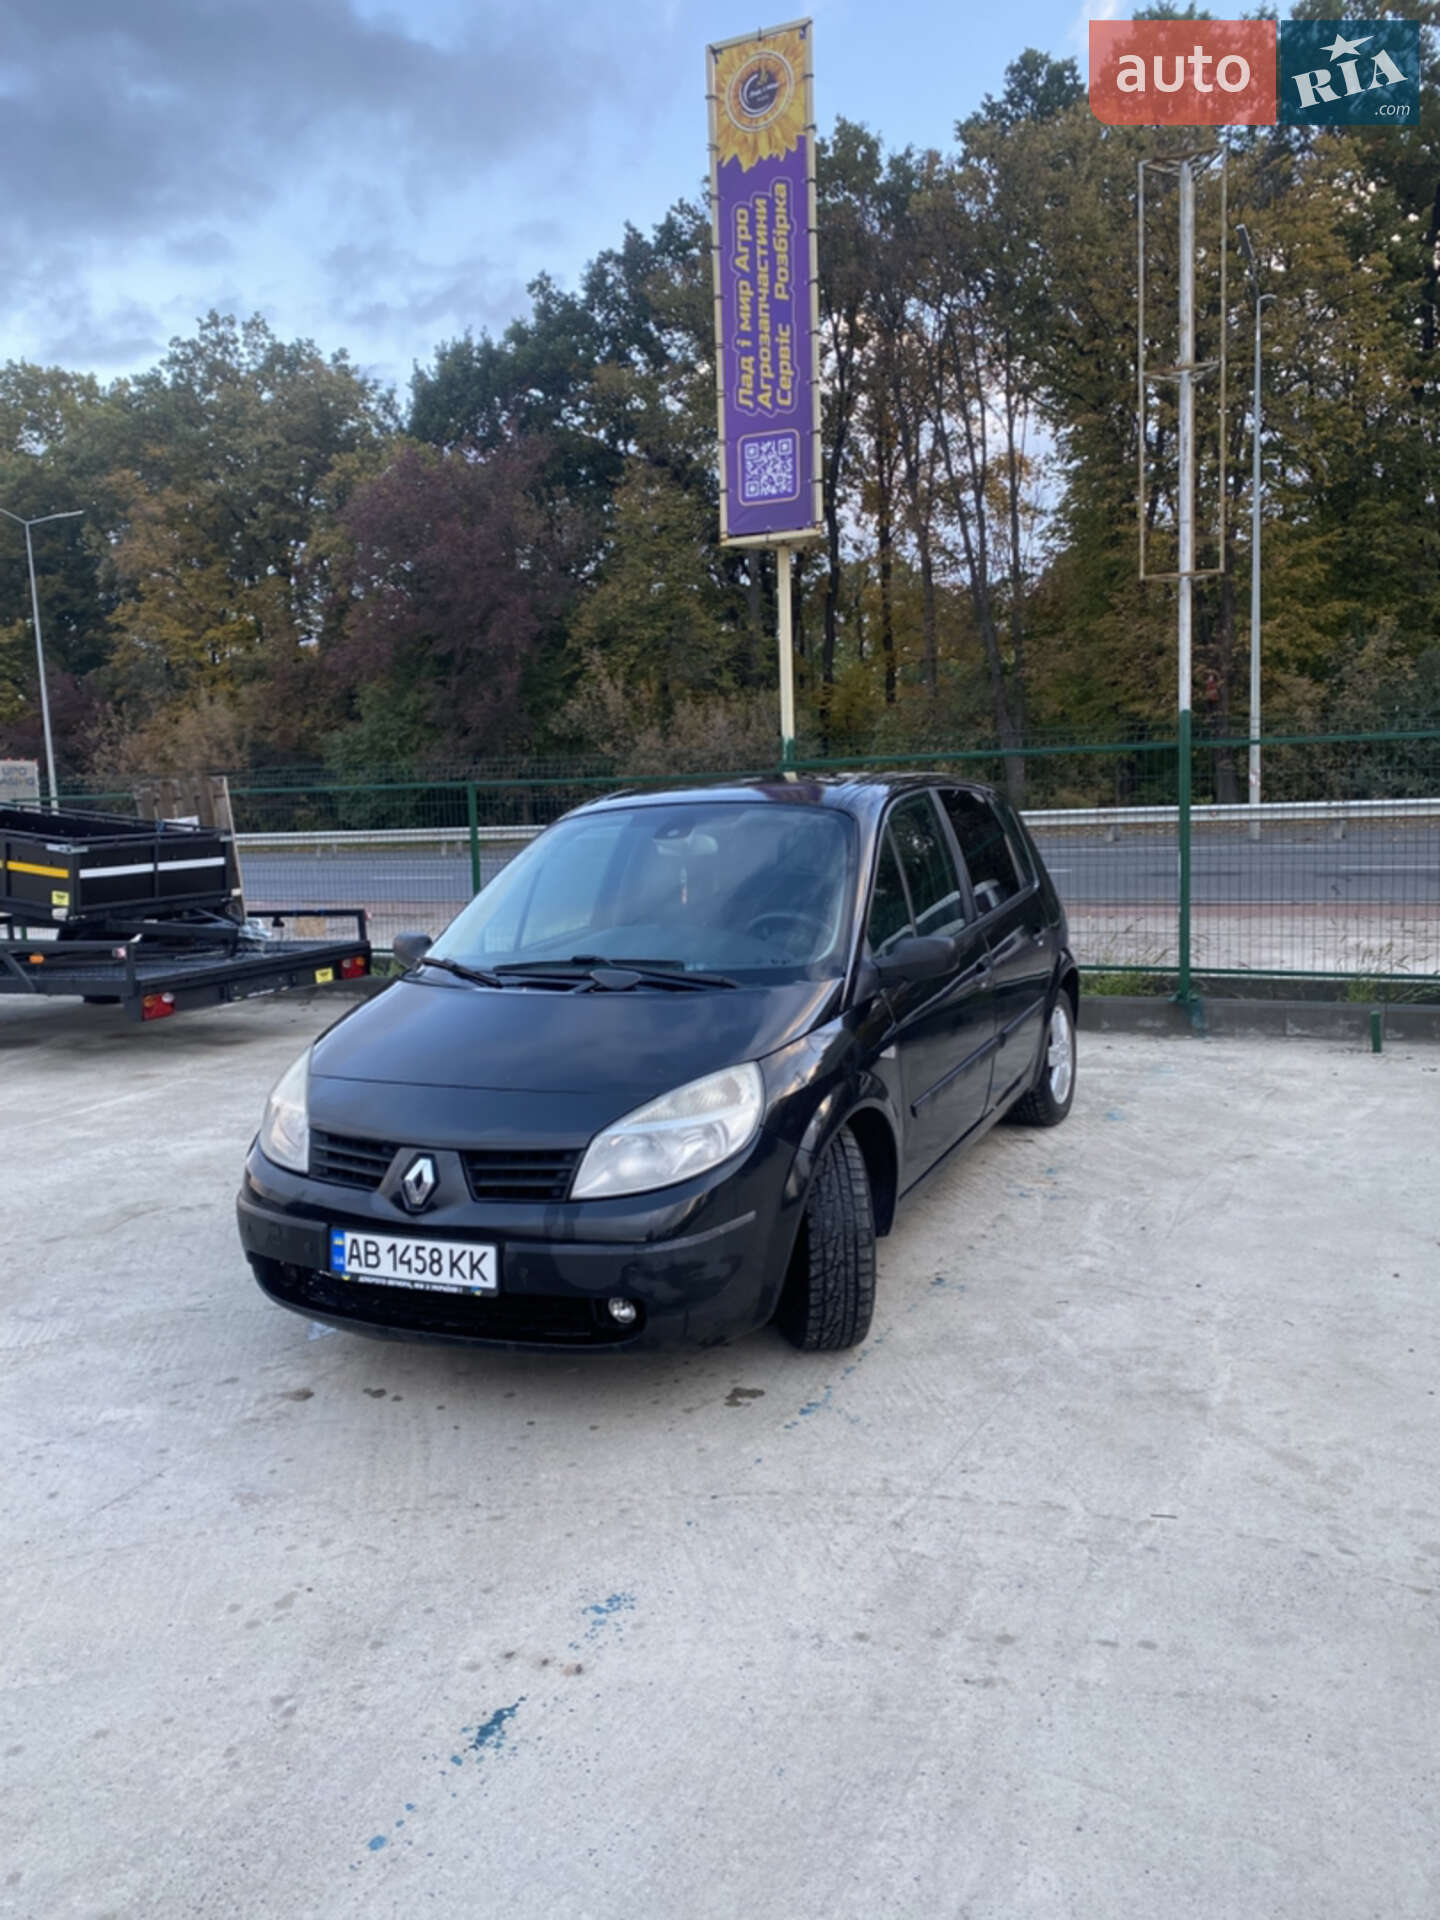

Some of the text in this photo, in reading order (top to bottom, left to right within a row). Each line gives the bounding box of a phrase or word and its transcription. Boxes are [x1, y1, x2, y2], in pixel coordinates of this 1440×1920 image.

[735, 208, 753, 271] Агро
[738, 279, 754, 331] мир
[755, 198, 774, 410] Агрозапчастини
[772, 183, 795, 406] Сервіс Розбірка
[738, 355, 755, 407] Лад
[348, 1238, 489, 1282] AB 1458 KK
